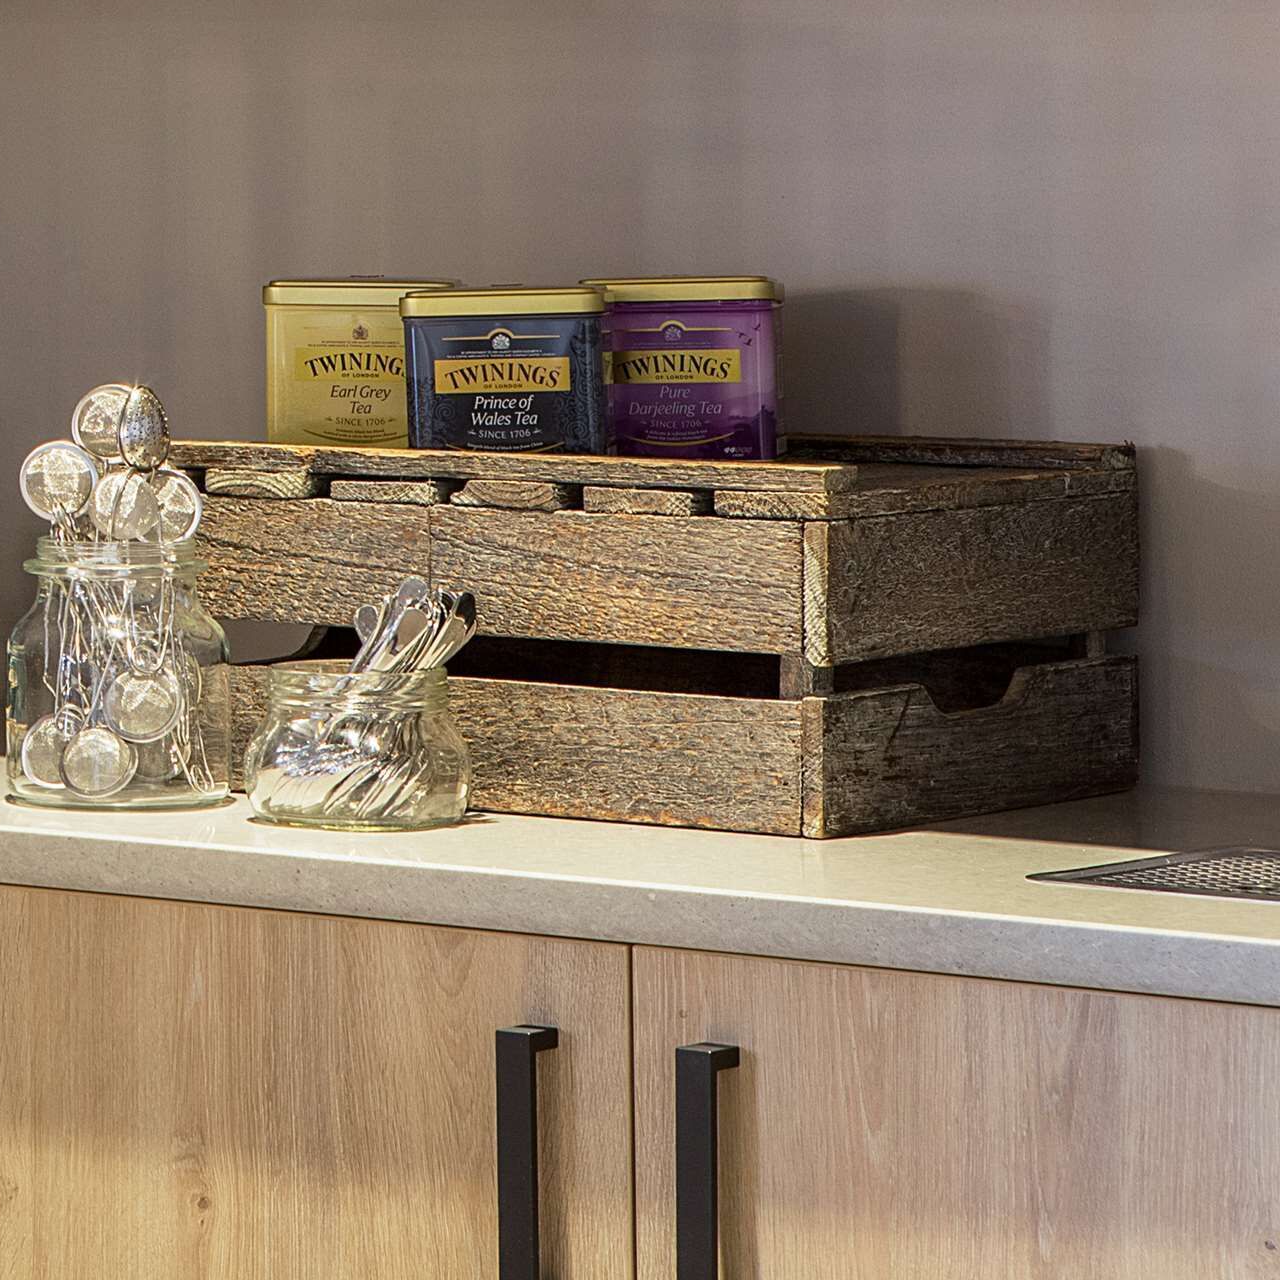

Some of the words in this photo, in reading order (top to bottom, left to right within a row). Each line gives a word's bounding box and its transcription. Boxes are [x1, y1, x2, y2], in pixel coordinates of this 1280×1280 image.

[304, 352, 406, 377] TWINING
[618, 354, 730, 380] TWININGS
[445, 362, 560, 390] TWININGS
[330, 385, 357, 398] Earl
[360, 385, 391, 401] Grey
[660, 386, 690, 398] Pure
[350, 401, 372, 414] Tea
[474, 396, 516, 410] Prince
[519, 395, 534, 411] of
[629, 402, 696, 417] Darjeeling
[700, 401, 722, 414] Tea
[336, 417, 361, 426] SINCE
[366, 416, 386, 426] 1706
[471, 412, 511, 426] Wales
[515, 412, 538, 425] Tea
[478, 430, 506, 439] SINCE
[510, 429, 531, 439] 1706
